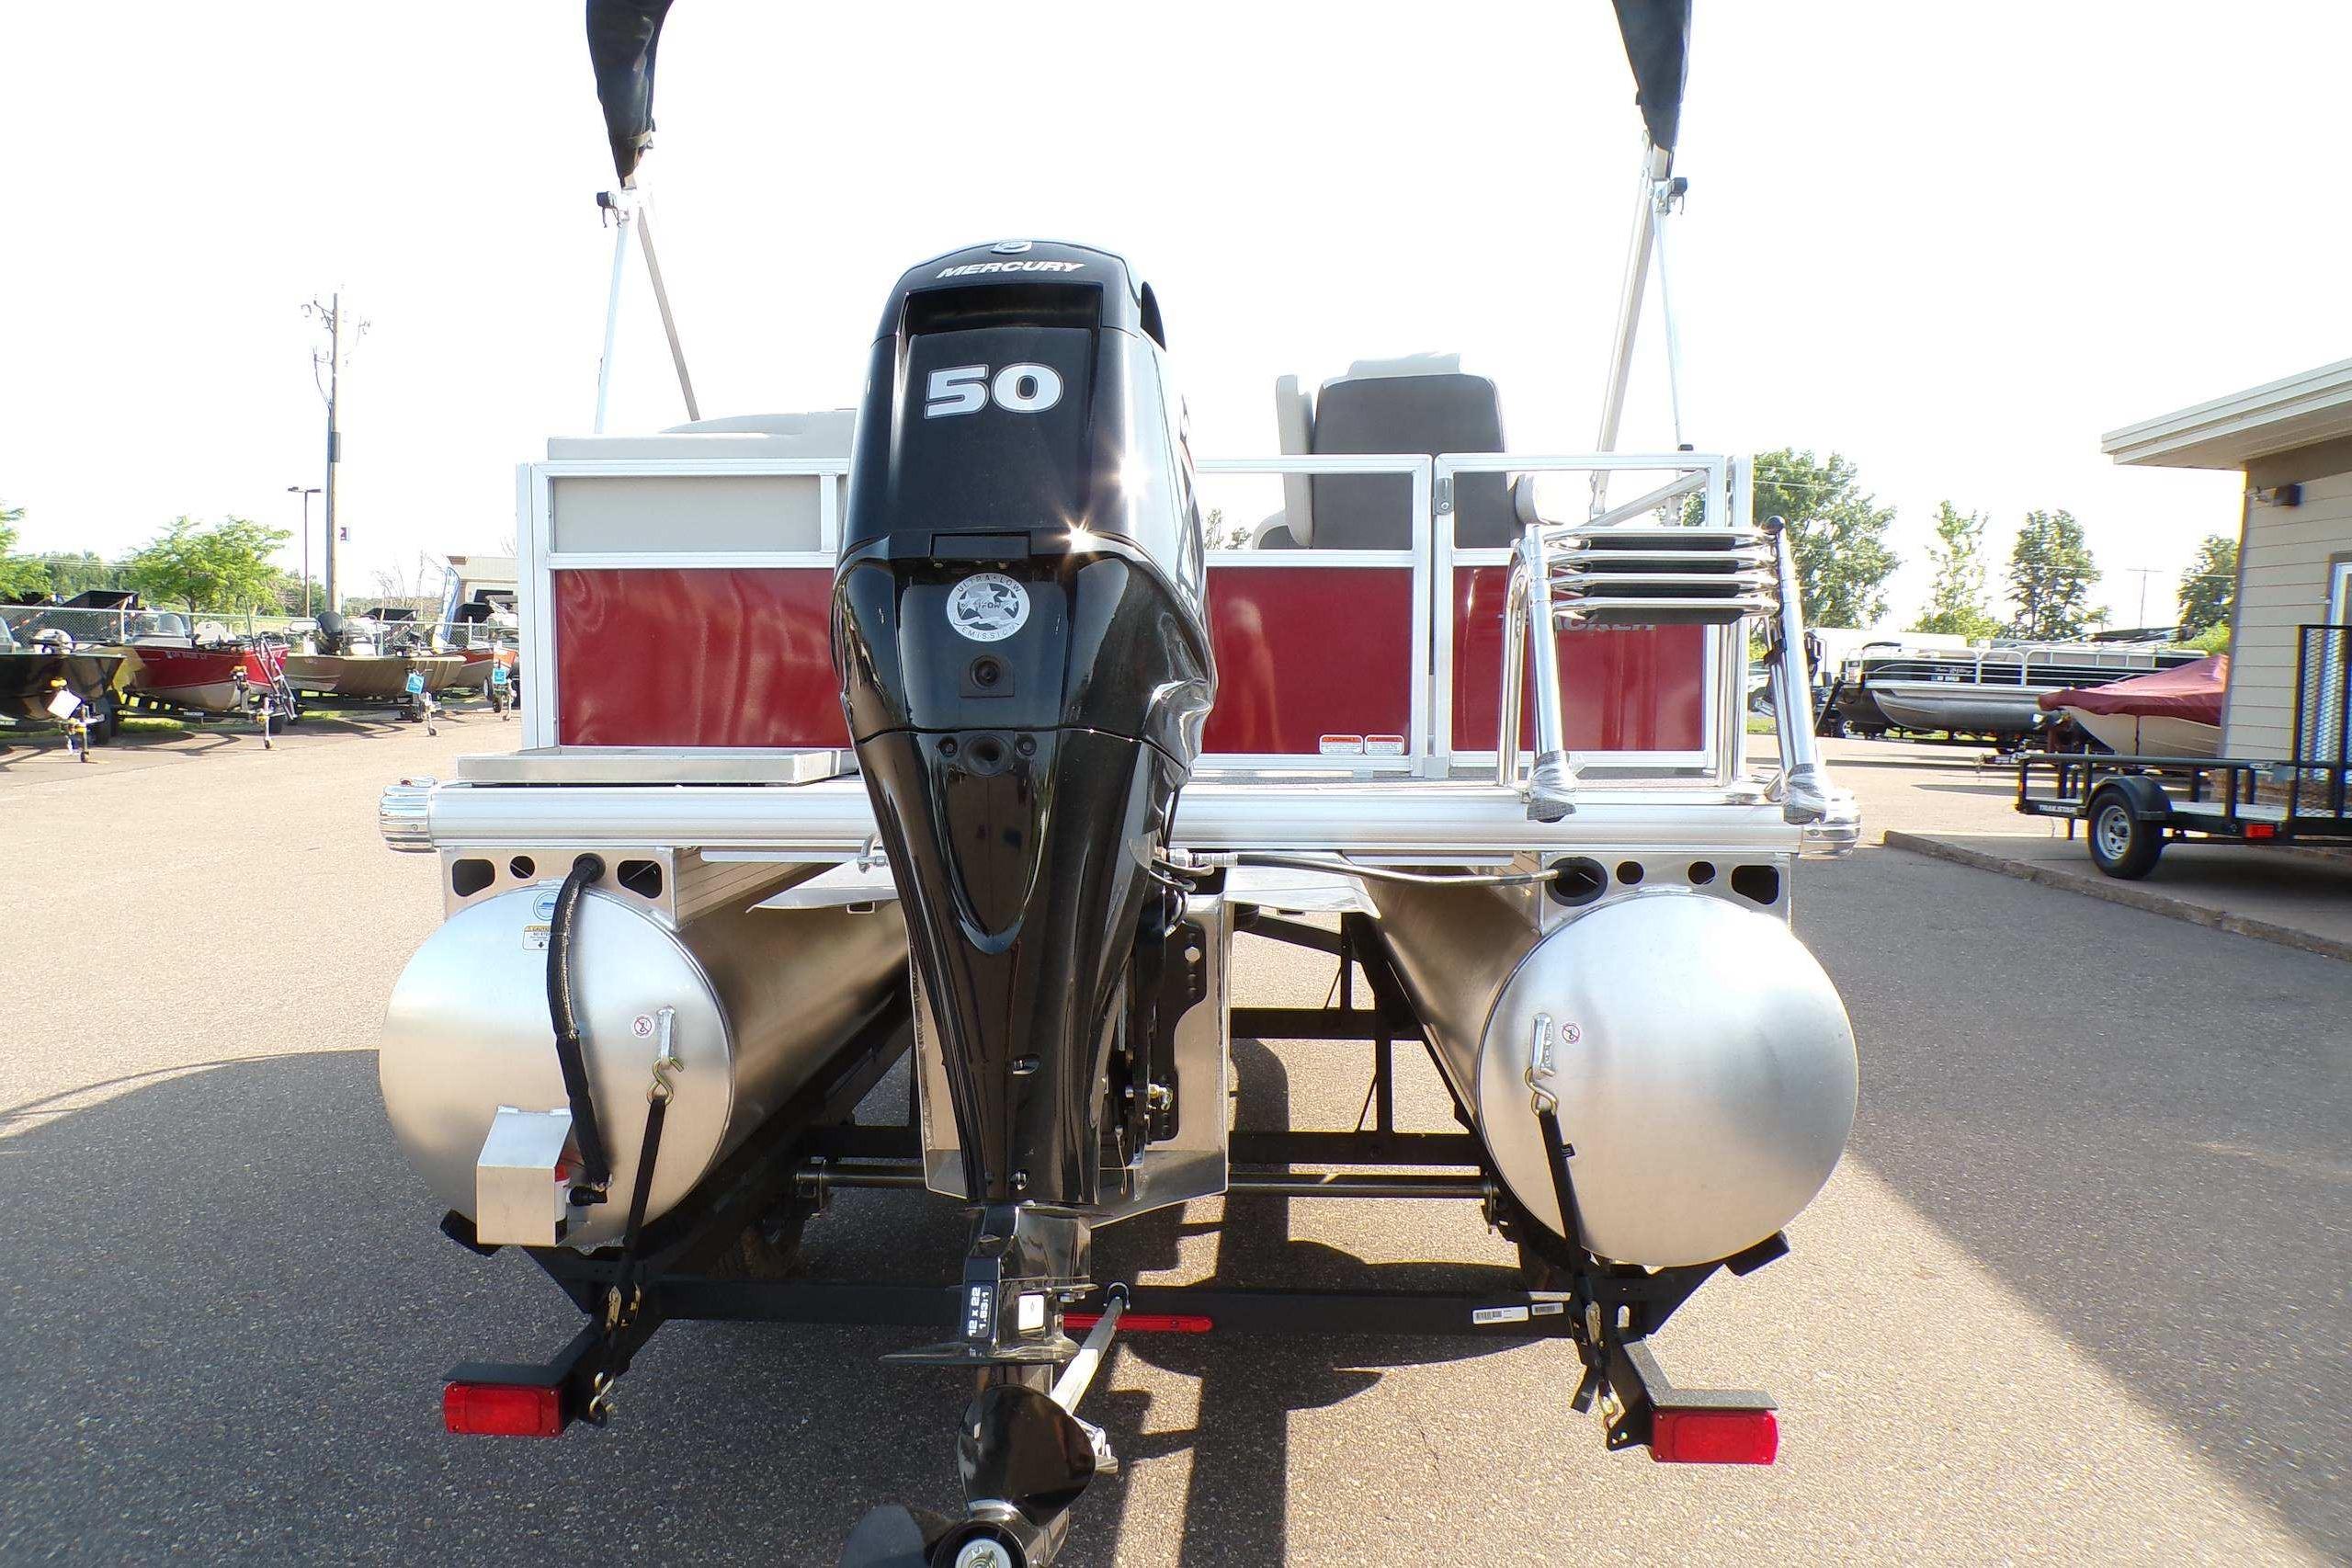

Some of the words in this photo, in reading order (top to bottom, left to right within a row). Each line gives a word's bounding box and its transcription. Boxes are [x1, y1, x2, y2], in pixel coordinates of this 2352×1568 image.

[937, 260, 1085, 279] MERCURY
[923, 361, 1065, 419] 50
[957, 574, 991, 593] ULTRA
[1000, 574, 1022, 594] LOW
[971, 1287, 981, 1307] 22
[968, 1319, 978, 1337] 12
